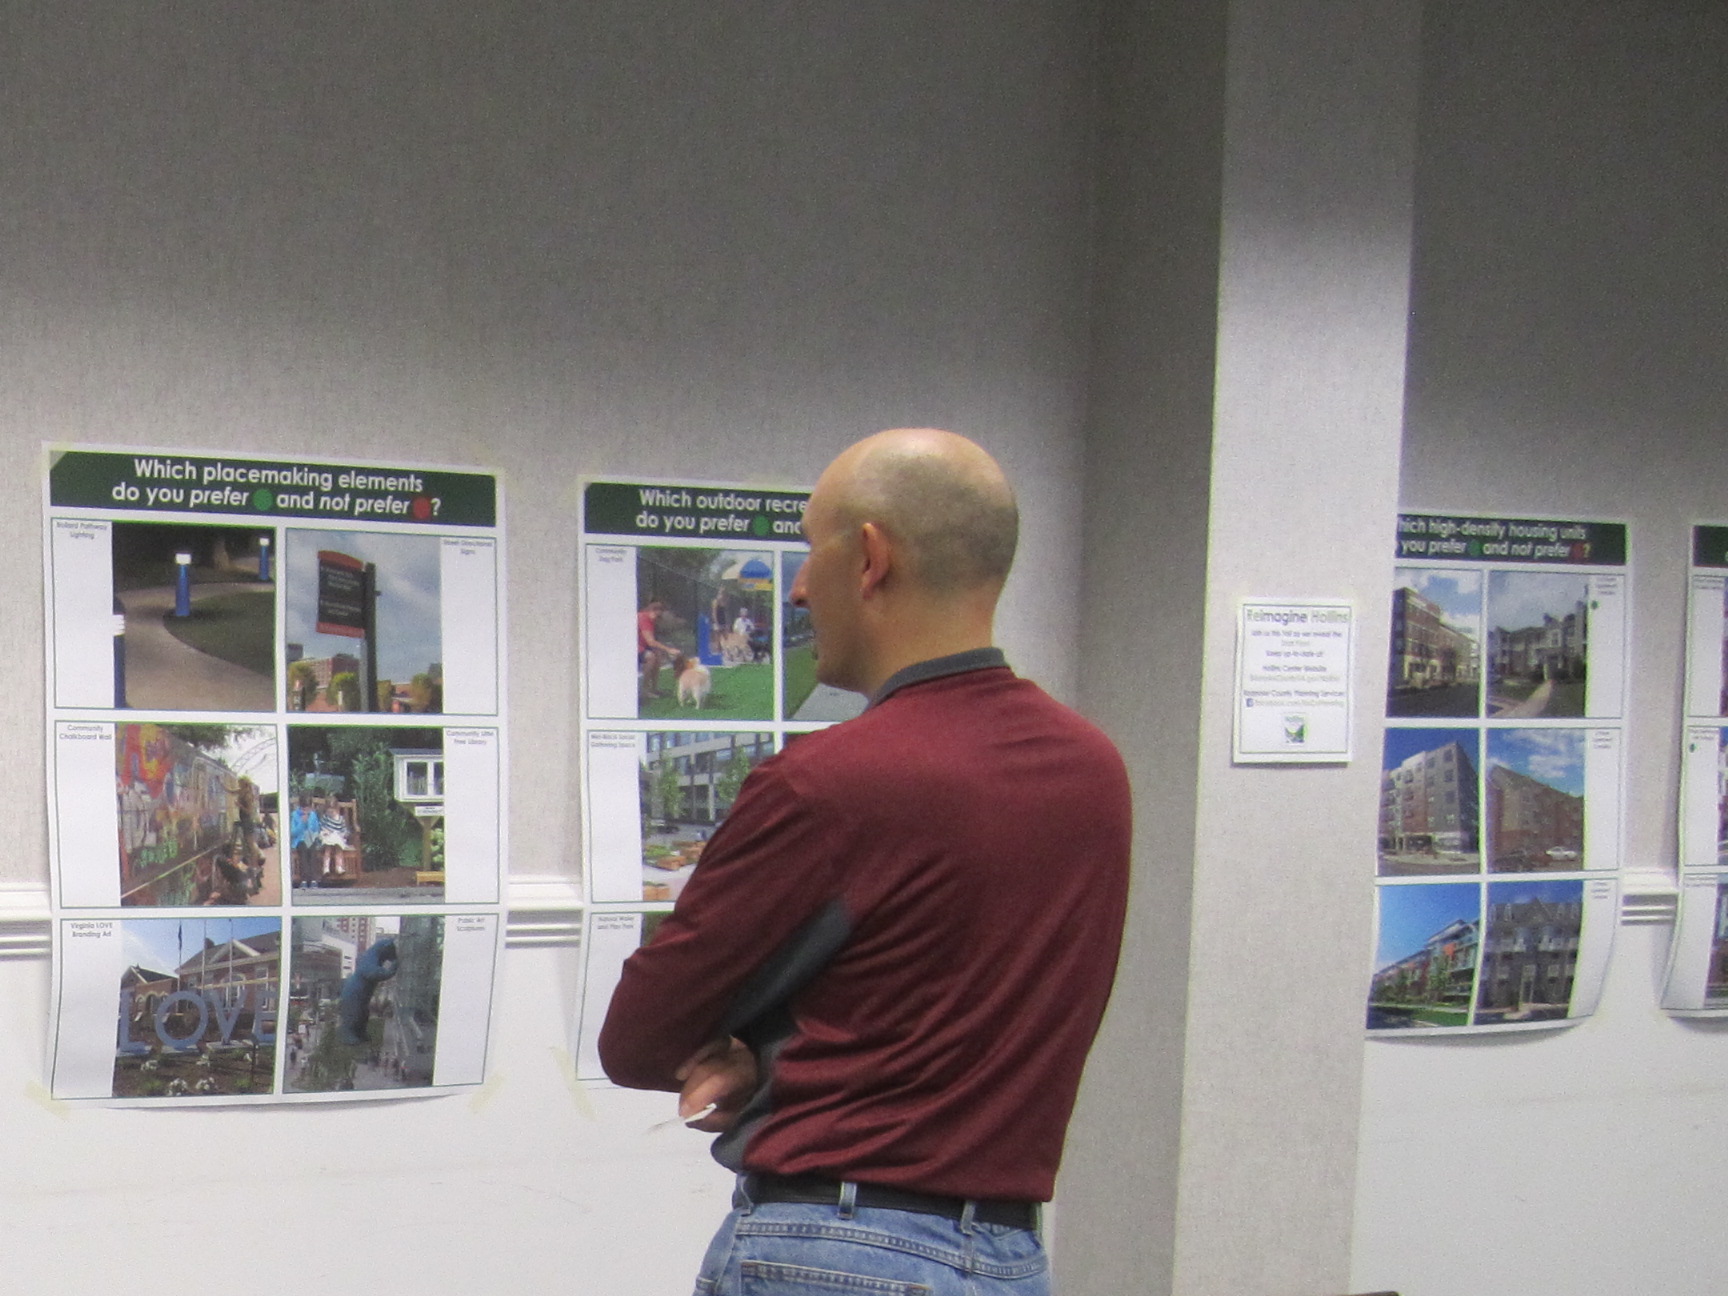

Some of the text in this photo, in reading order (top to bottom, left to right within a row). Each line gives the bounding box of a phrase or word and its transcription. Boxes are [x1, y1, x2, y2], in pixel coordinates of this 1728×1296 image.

[134, 458, 423, 492] Which placemaking elements
[112, 482, 441, 516] do you prefer and not prefer ?
[639, 489, 807, 512] Which outdoor recre
[636, 511, 659, 528] do
[664, 516, 695, 532] you
[699, 514, 749, 534] prefer
[1398, 518, 1587, 542] hich high-density housing units
[1401, 540, 1426, 555] you
[1428, 539, 1467, 556] prefer
[1483, 541, 1508, 555] and
[1511, 542, 1533, 556] not
[1534, 542, 1571, 558] prefer
[1247, 609, 1307, 626] Reimagine
[119, 989, 277, 1051] LOVE
